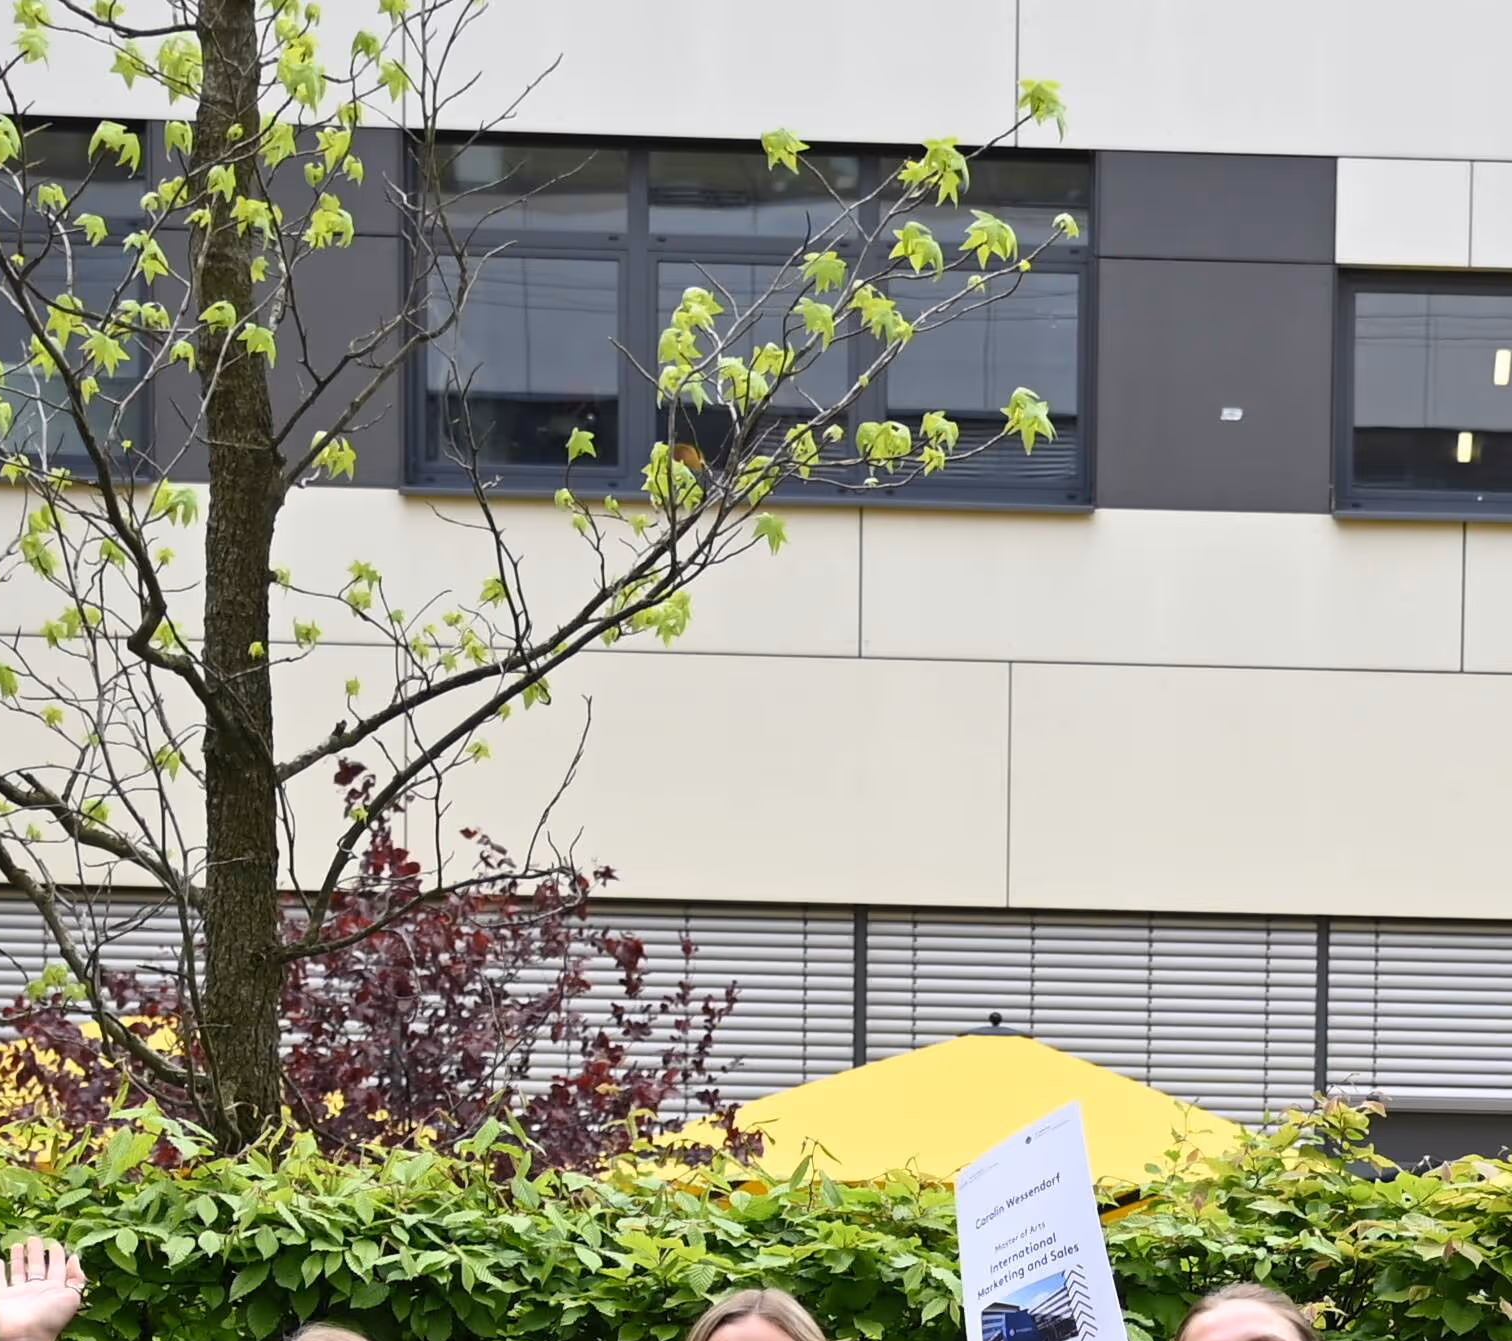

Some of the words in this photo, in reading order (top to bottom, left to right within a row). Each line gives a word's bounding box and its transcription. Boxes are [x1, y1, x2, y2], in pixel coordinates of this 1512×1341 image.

[975, 1205, 1005, 1230] Carolin
[1005, 1171, 1061, 1209] Wessendorf
[989, 1231, 1057, 1274] International
[994, 1234, 1019, 1253] Master
[1019, 1227, 1028, 1239] of
[1029, 1221, 1046, 1235] Arts
[977, 1267, 1025, 1301] Marketing
[1027, 1252, 1049, 1272] and
[1049, 1243, 1080, 1262] Sales
